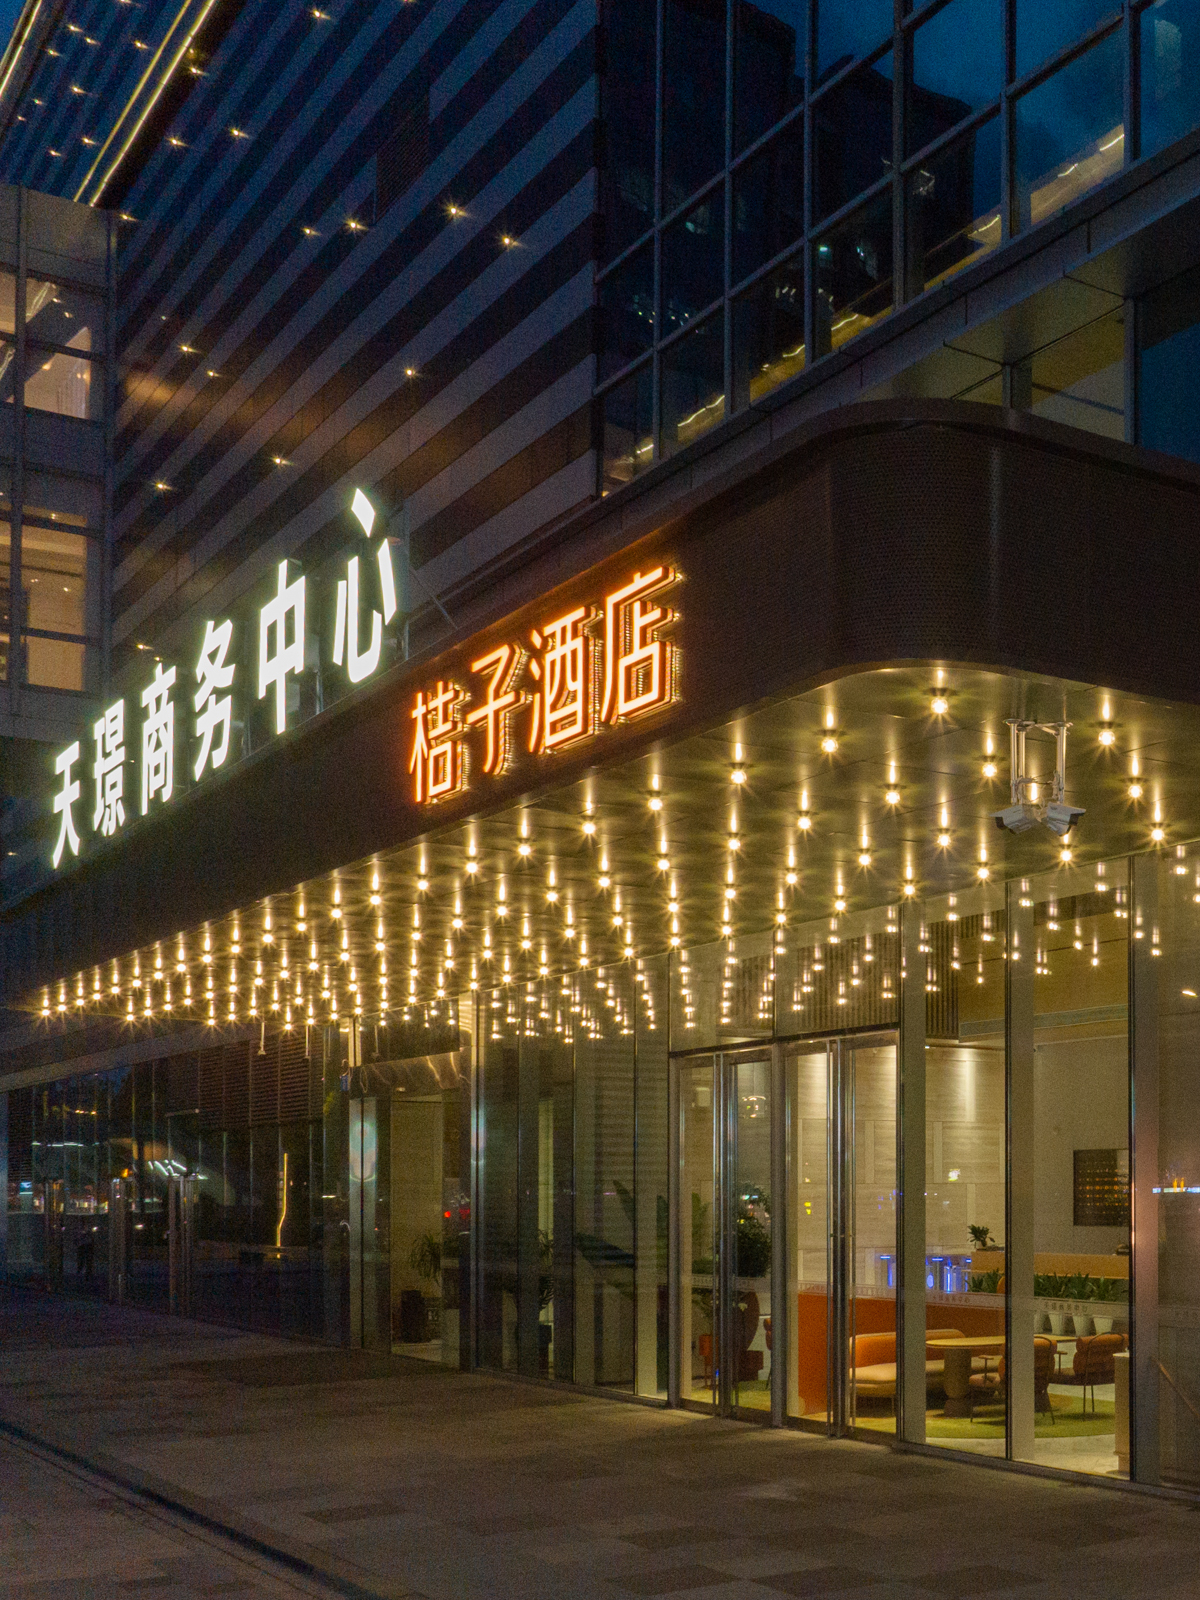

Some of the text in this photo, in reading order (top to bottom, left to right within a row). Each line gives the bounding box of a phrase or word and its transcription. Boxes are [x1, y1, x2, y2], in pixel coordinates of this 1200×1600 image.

[51, 487, 398, 868] 天璟商务中心
[408, 566, 683, 804] 桔子酒店
